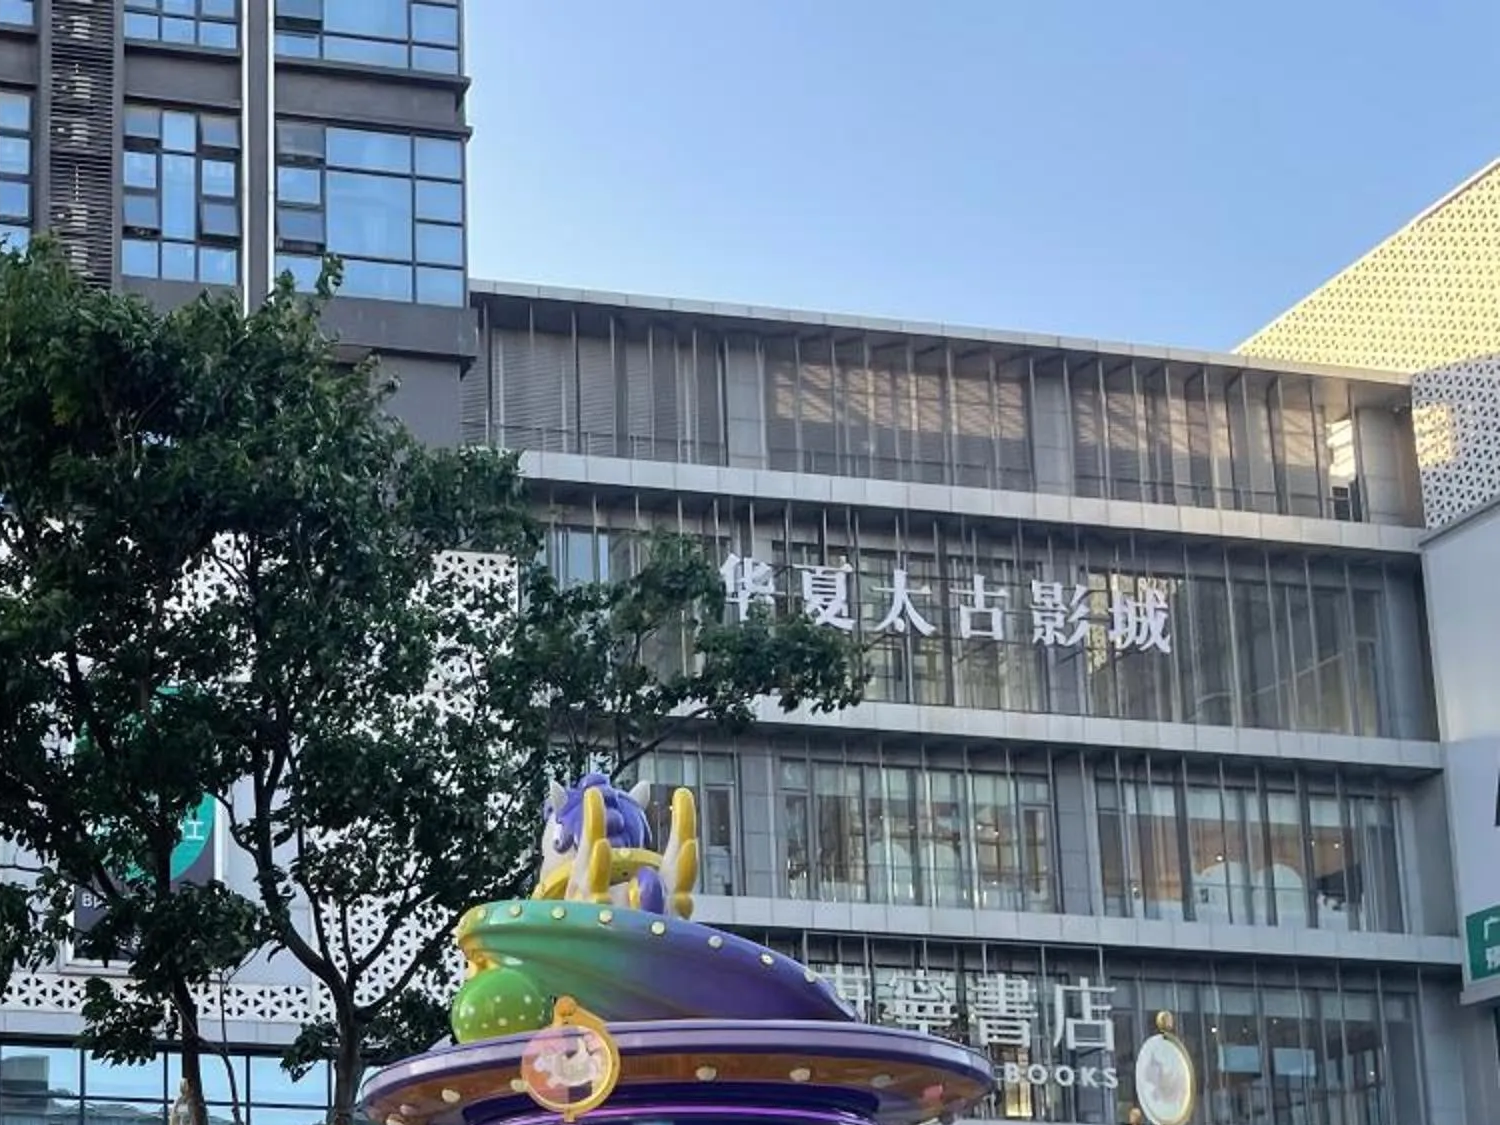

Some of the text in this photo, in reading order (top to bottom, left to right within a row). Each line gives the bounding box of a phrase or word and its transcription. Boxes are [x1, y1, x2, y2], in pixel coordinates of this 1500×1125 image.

[720, 553, 1172, 654] 华夏太古影城
[1004, 1061, 1119, 1089] BOOKS
